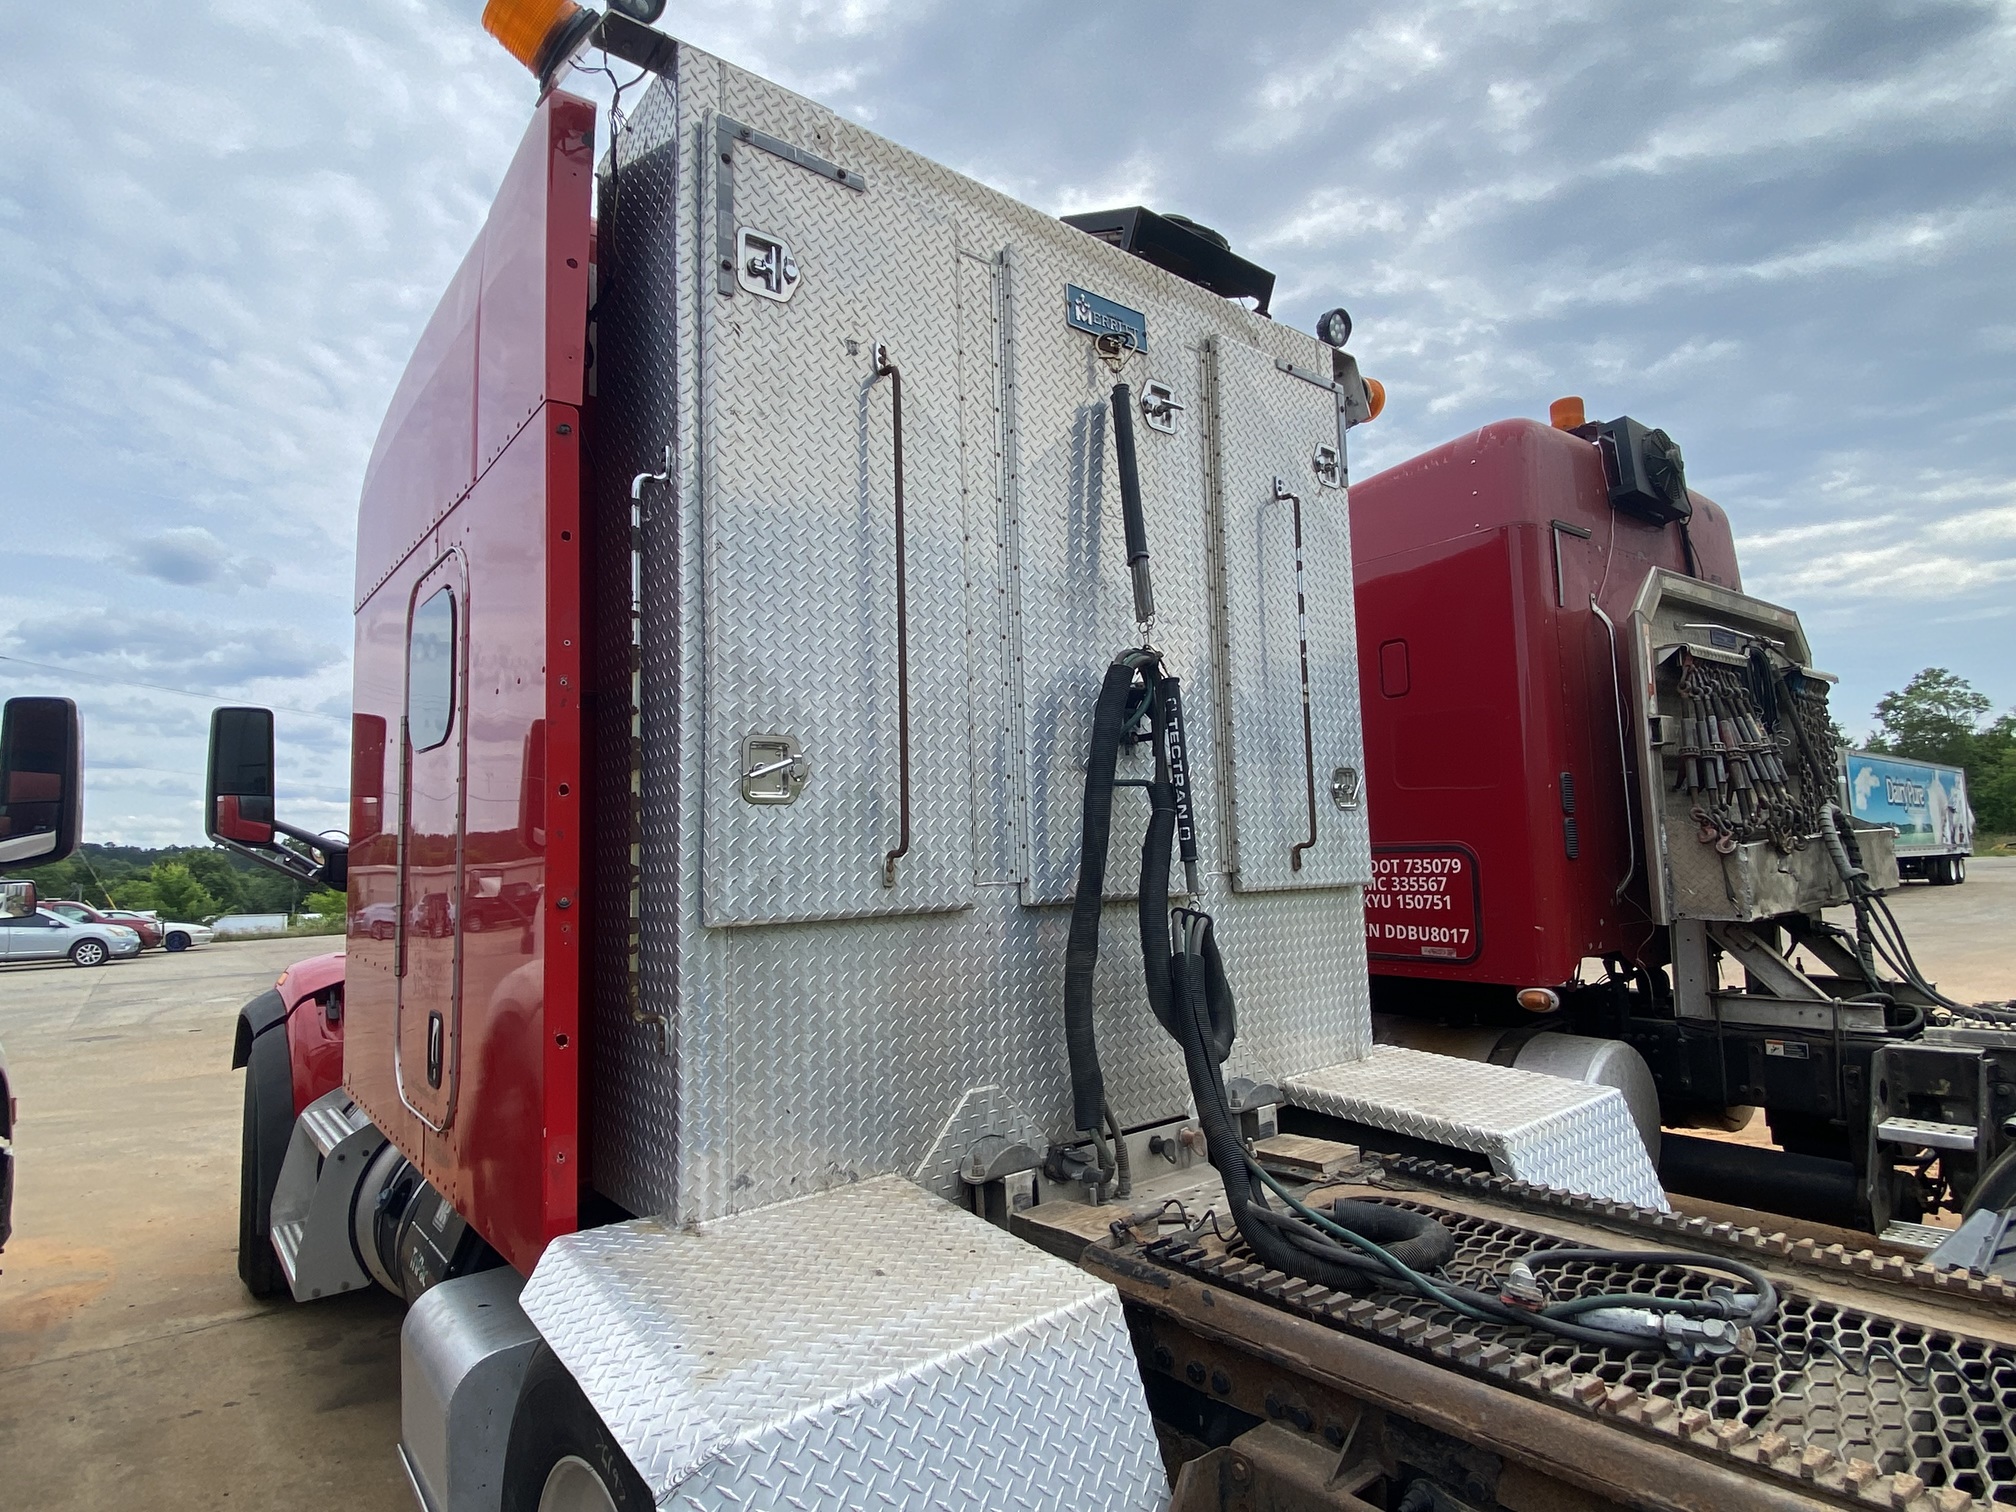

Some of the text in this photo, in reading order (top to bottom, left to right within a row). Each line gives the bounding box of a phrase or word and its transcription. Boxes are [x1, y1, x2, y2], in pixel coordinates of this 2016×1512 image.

[1075, 300, 1139, 336] MERRITT
[1168, 717, 1189, 820] TECTRAN
[1403, 858, 1462, 874] 735079
[1391, 876, 1447, 892] 335567
[1396, 894, 1451, 910] 150751
[1385, 924, 1470, 944] DDBU8017
